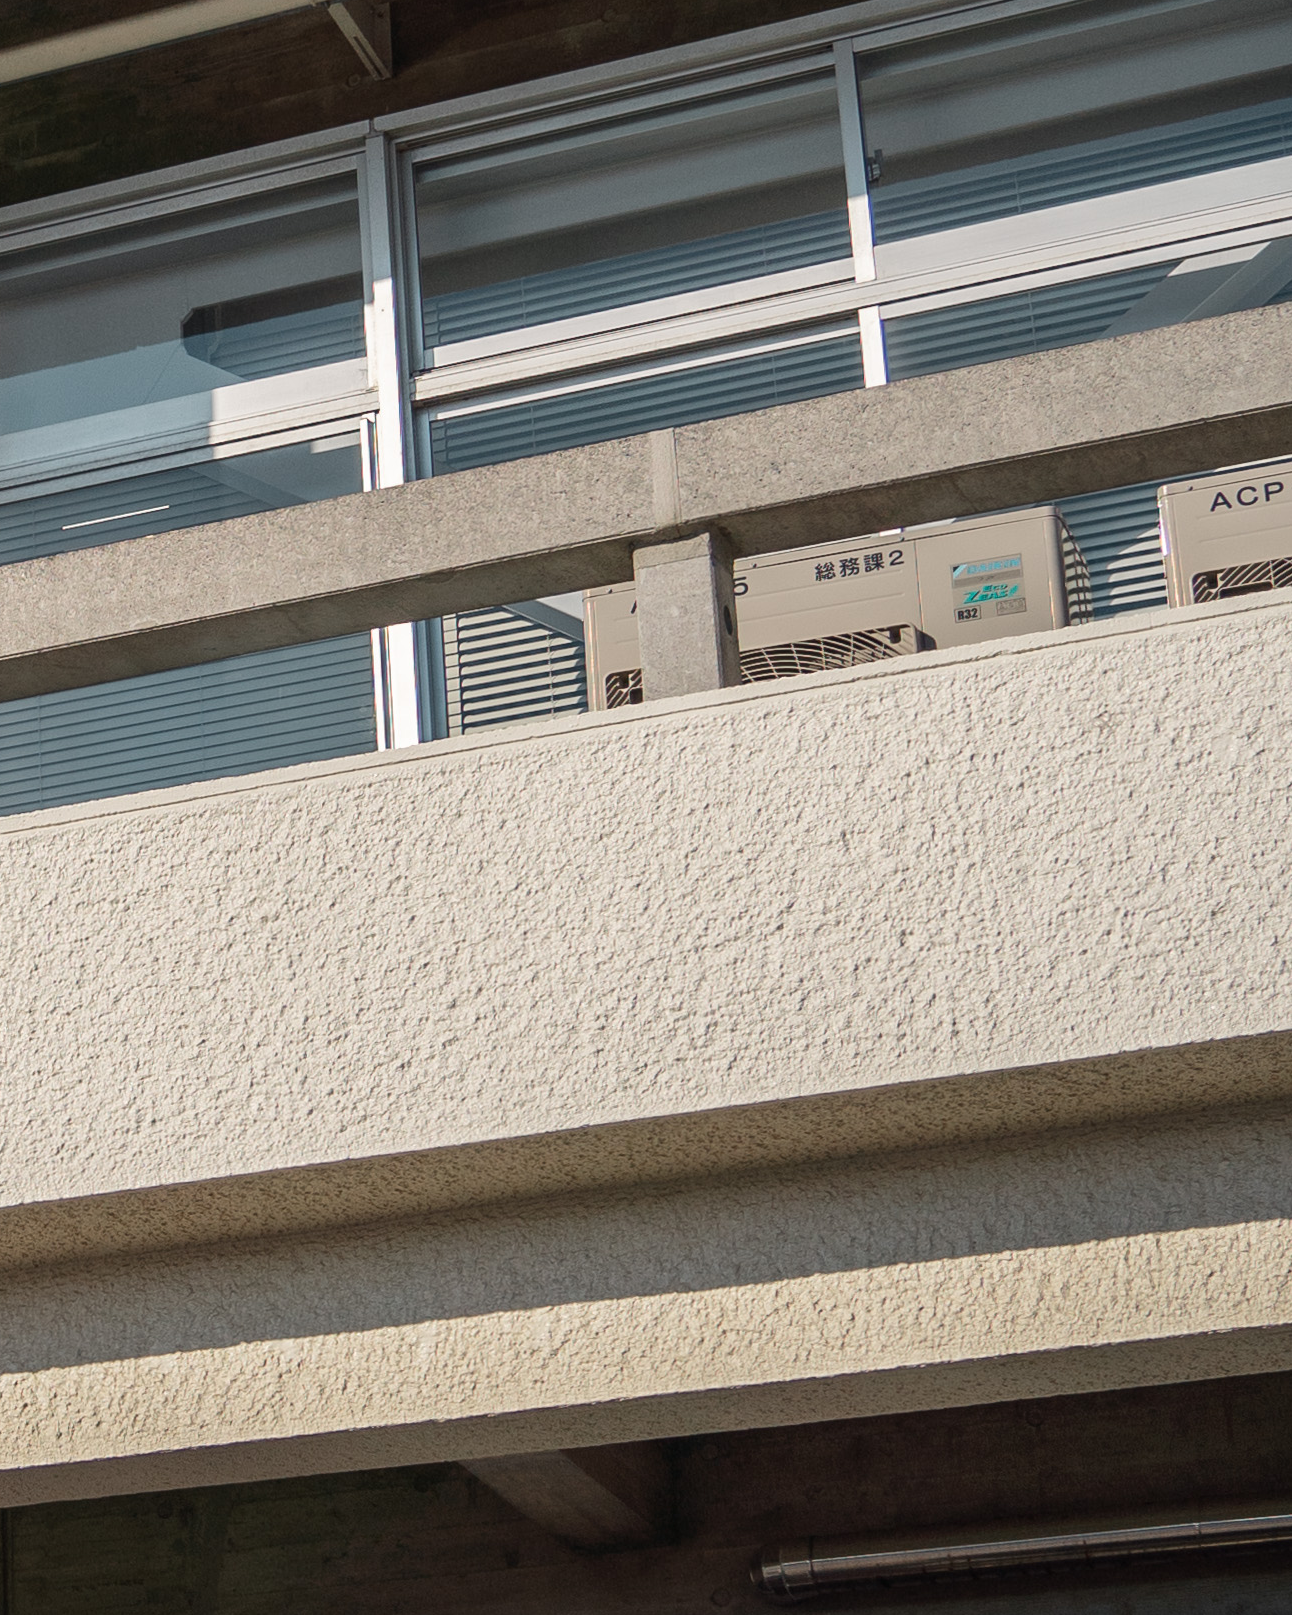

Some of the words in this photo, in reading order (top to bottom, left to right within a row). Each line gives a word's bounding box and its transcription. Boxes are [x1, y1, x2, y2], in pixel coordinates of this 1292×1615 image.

[1210, 481, 1285, 512] ACP
[814, 549, 905, 582] 総務課2
[957, 607, 979, 622] R32
